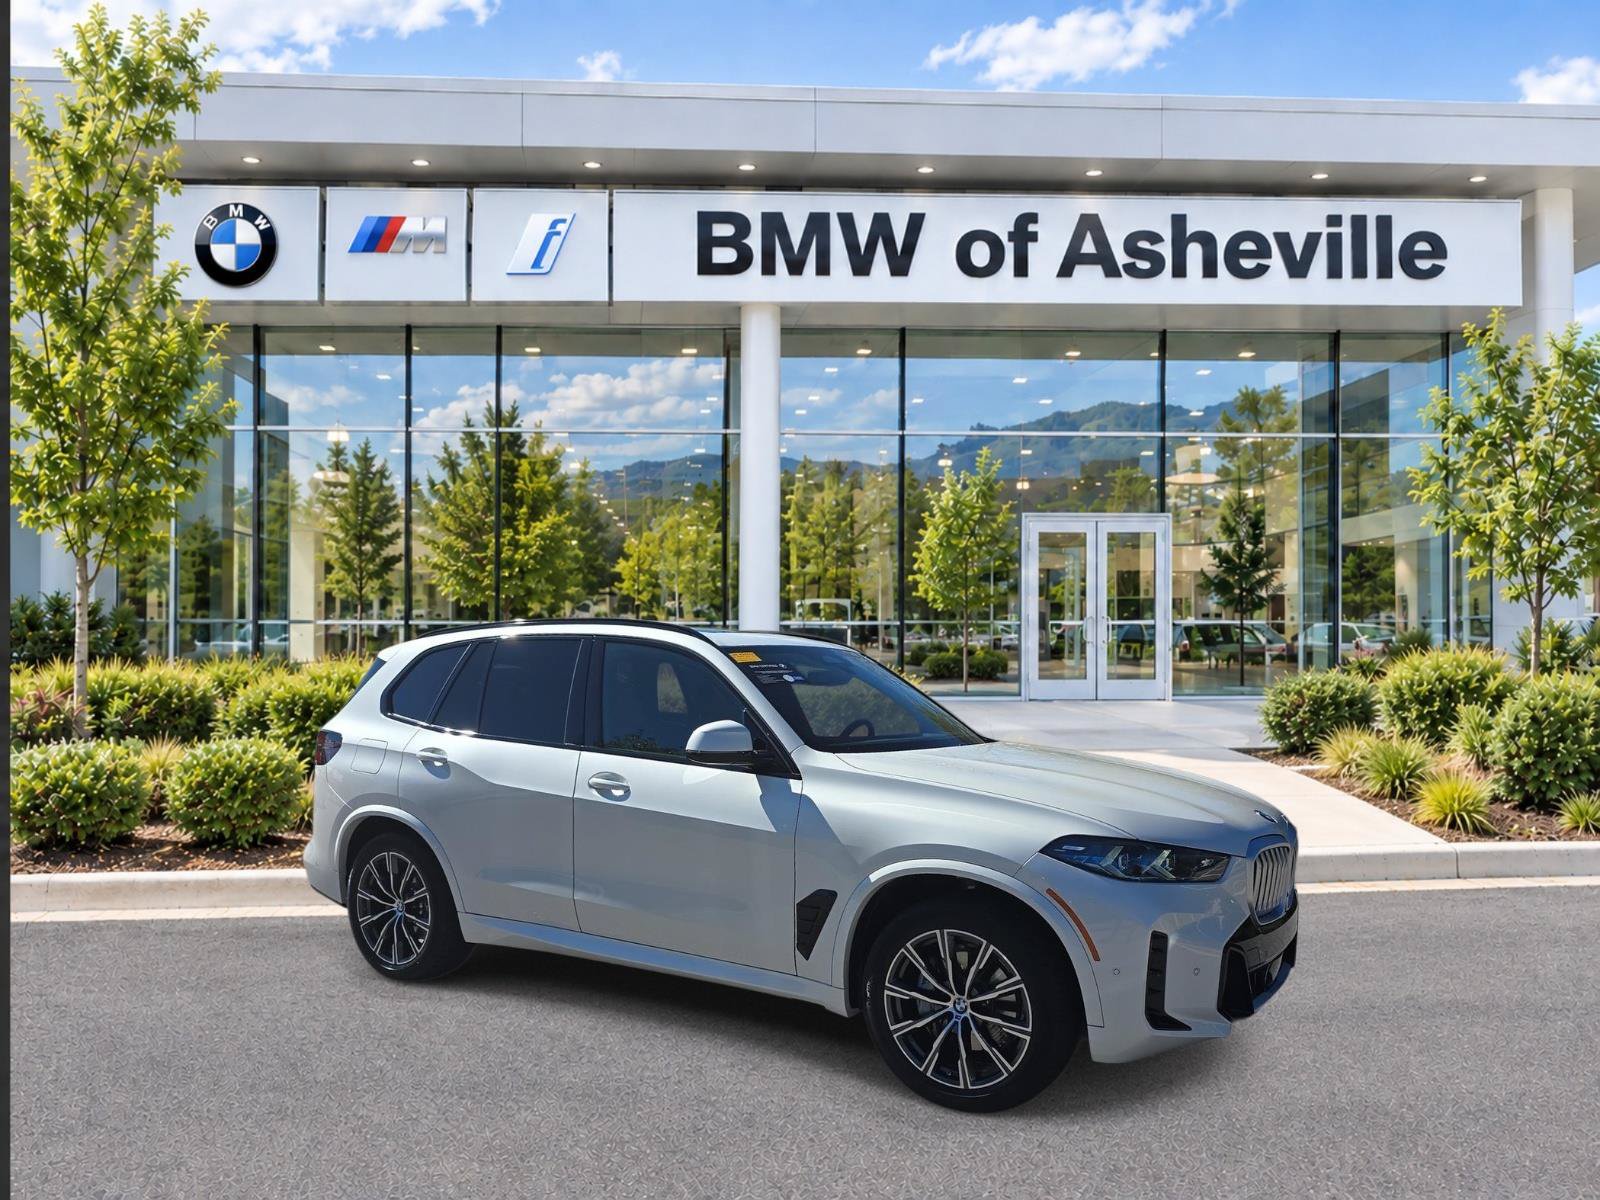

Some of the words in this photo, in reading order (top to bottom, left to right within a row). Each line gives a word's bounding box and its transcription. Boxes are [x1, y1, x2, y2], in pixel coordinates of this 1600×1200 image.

[203, 204, 271, 230] BMW
[389, 216, 448, 254] M
[697, 210, 926, 277] BMW
[955, 212, 1038, 278] of
[1056, 213, 1448, 280] Asheville
